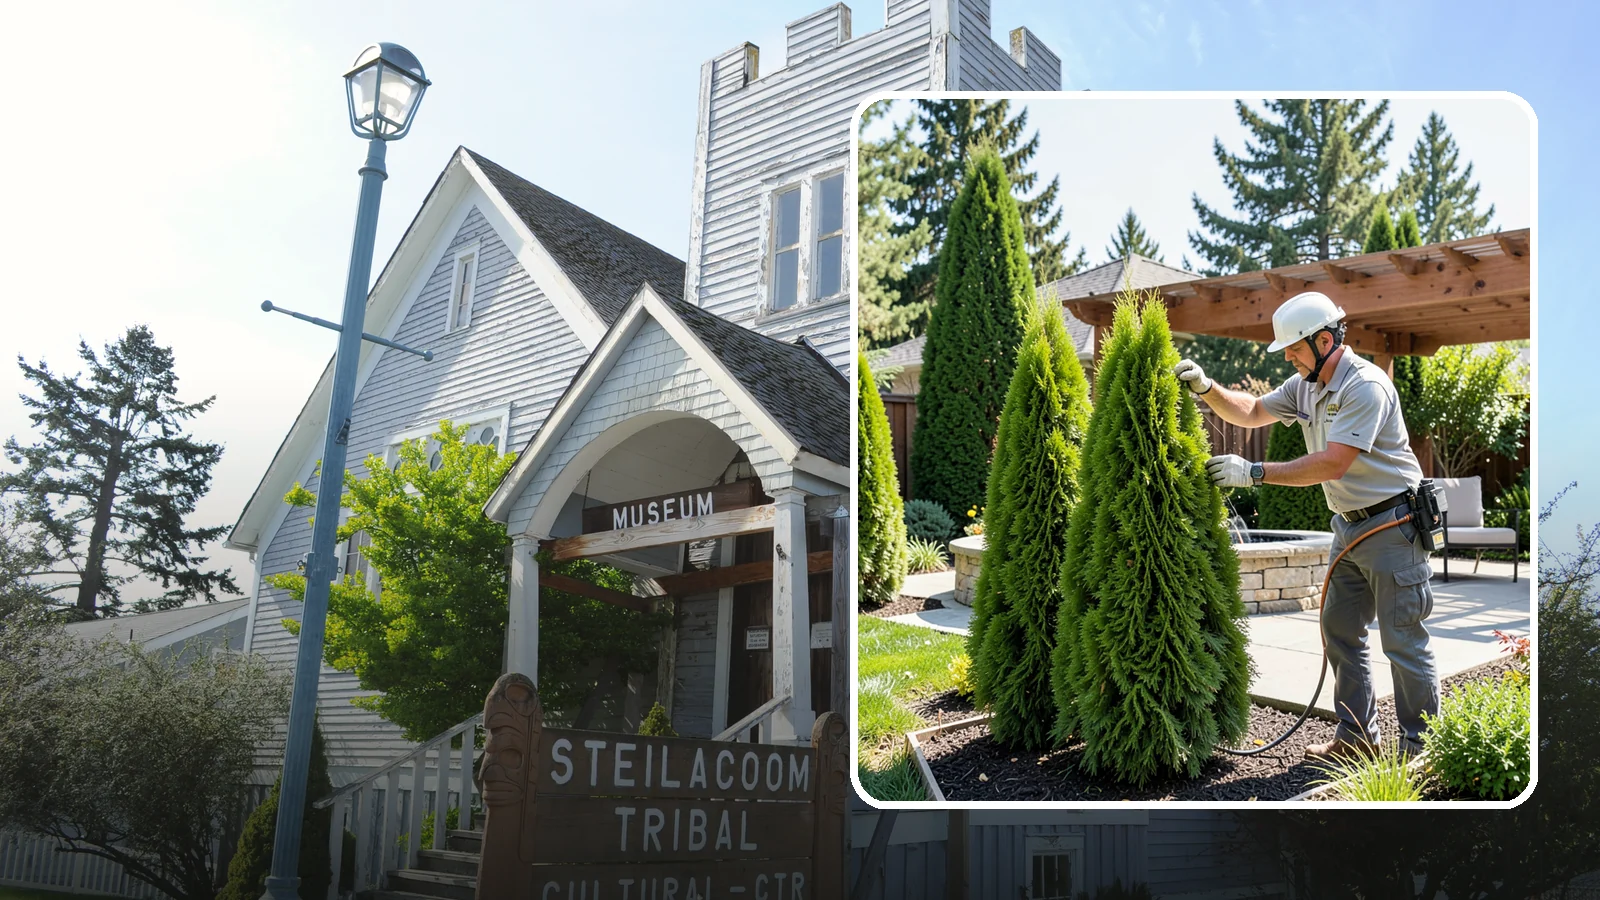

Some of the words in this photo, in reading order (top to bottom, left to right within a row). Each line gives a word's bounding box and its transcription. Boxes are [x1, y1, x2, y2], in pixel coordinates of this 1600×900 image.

[612, 491, 714, 531] MUSEUM
[550, 738, 810, 793] STEILACOOM
[614, 806, 758, 853] TRIBAL
